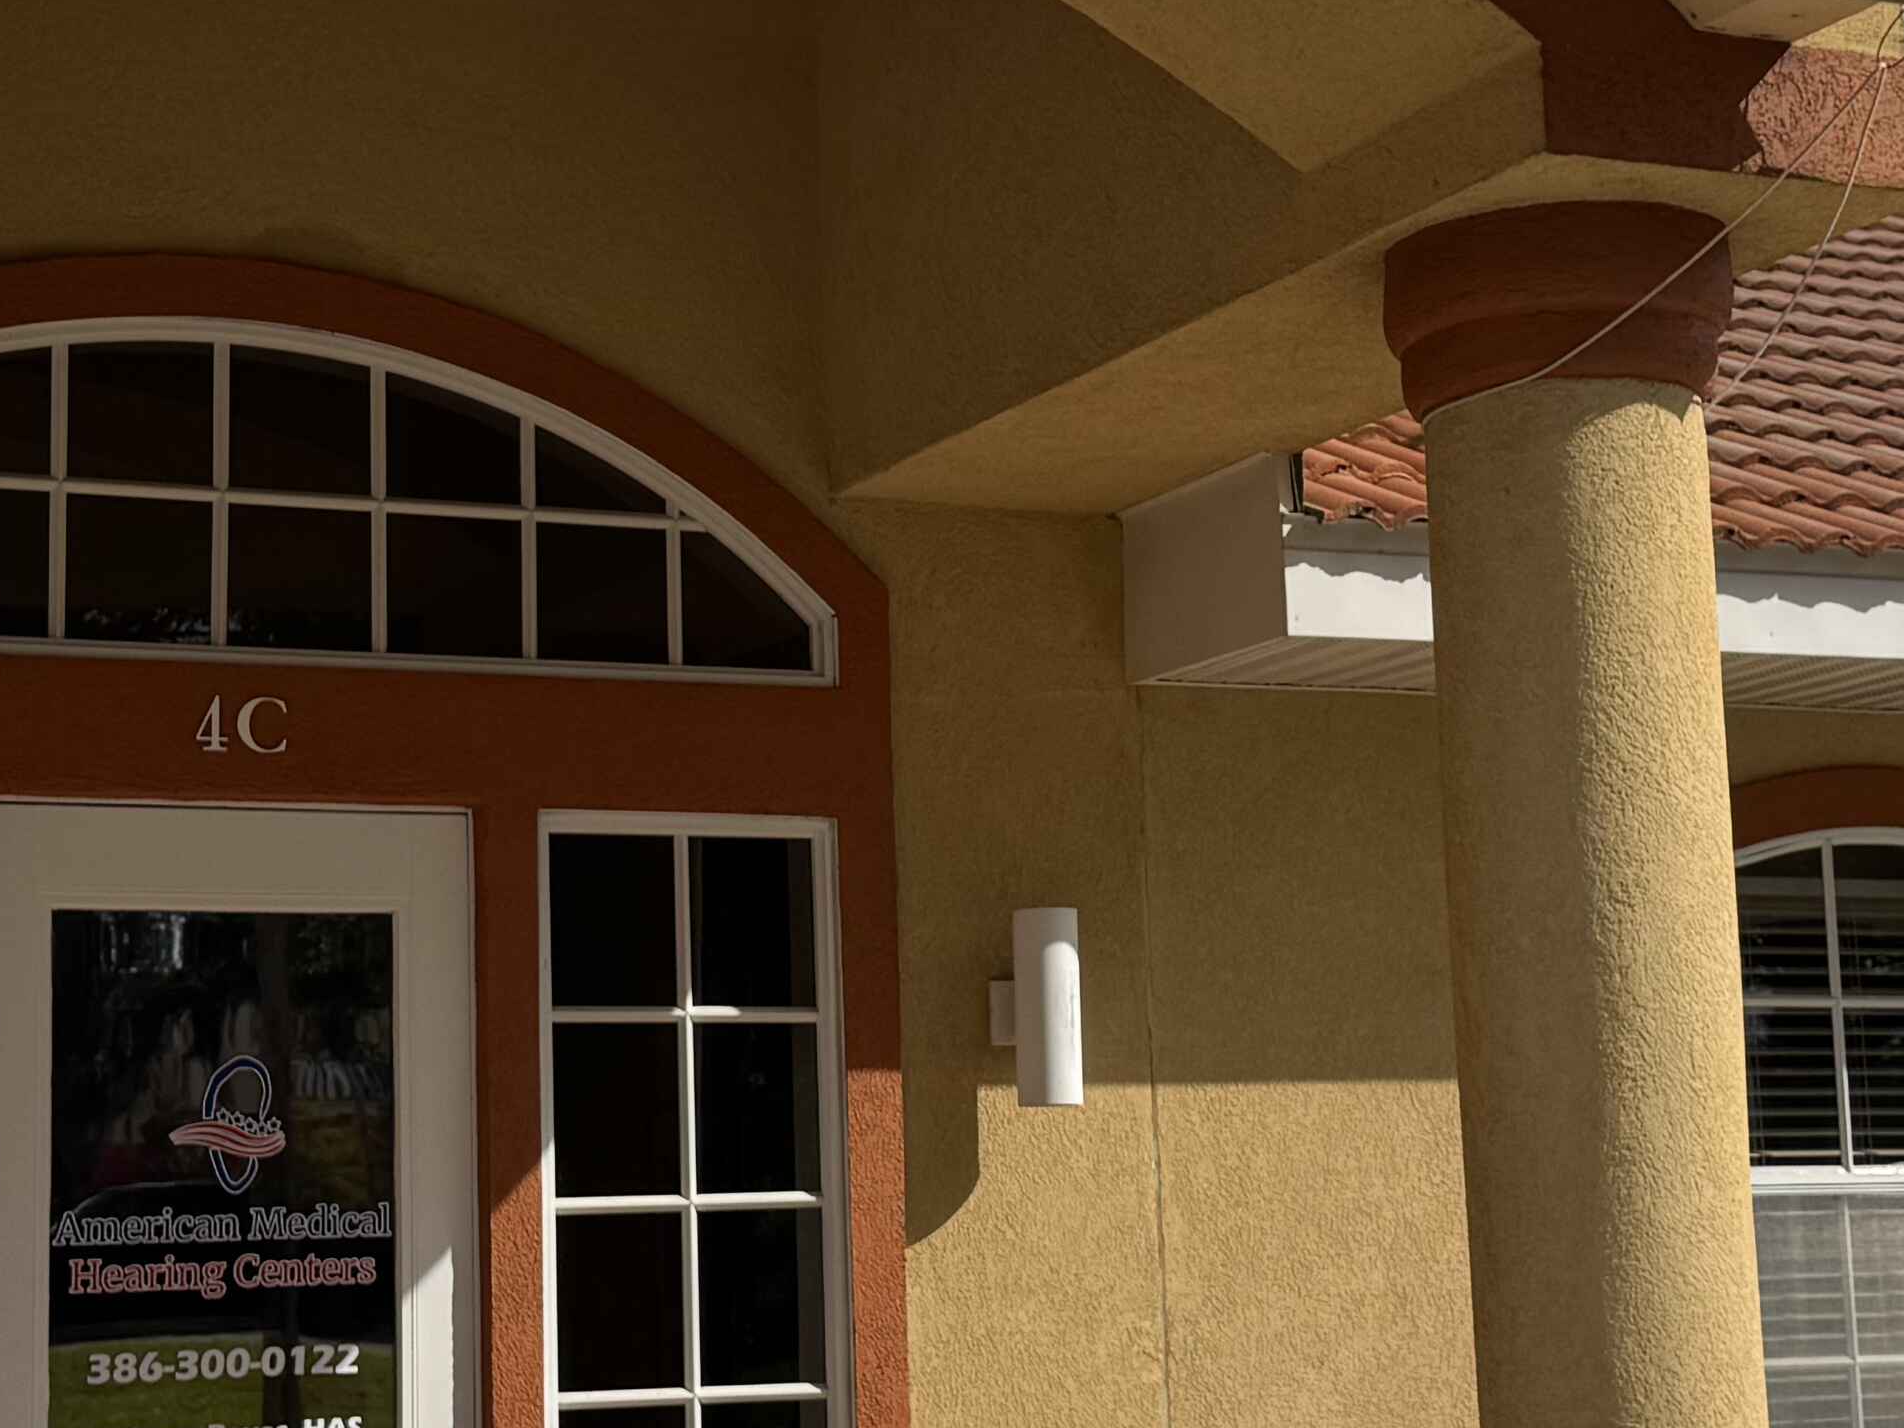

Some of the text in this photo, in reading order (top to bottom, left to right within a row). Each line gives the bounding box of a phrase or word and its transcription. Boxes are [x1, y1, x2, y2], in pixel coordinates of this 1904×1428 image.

[196, 694, 288, 753] 4C
[52, 1202, 392, 1247] American Medical
[68, 1253, 377, 1299] Hearing Centers
[87, 1344, 360, 1385] 386-300-0122
